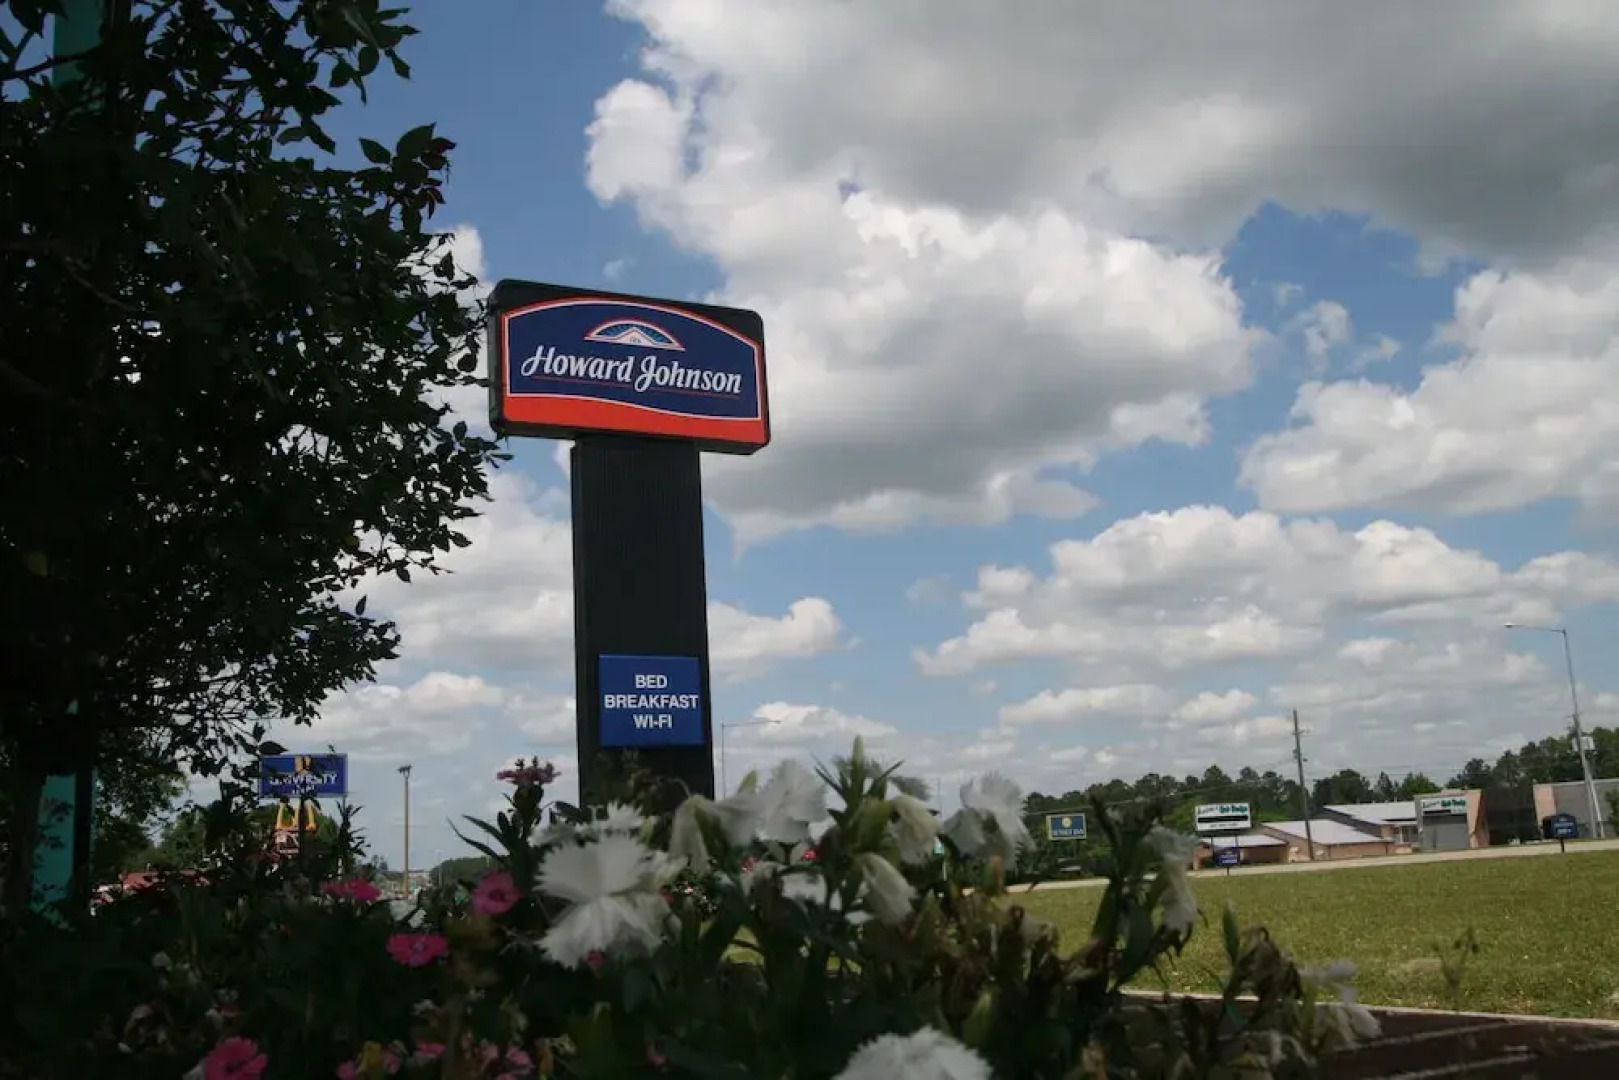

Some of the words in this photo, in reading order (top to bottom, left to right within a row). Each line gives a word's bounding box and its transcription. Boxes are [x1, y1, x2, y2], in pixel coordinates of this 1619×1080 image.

[521, 345, 634, 382] Howard
[634, 355, 742, 394] Johnson
[635, 674, 668, 689] BED
[604, 694, 699, 709] BREAKFAST
[632, 713, 673, 729] WI-FI
